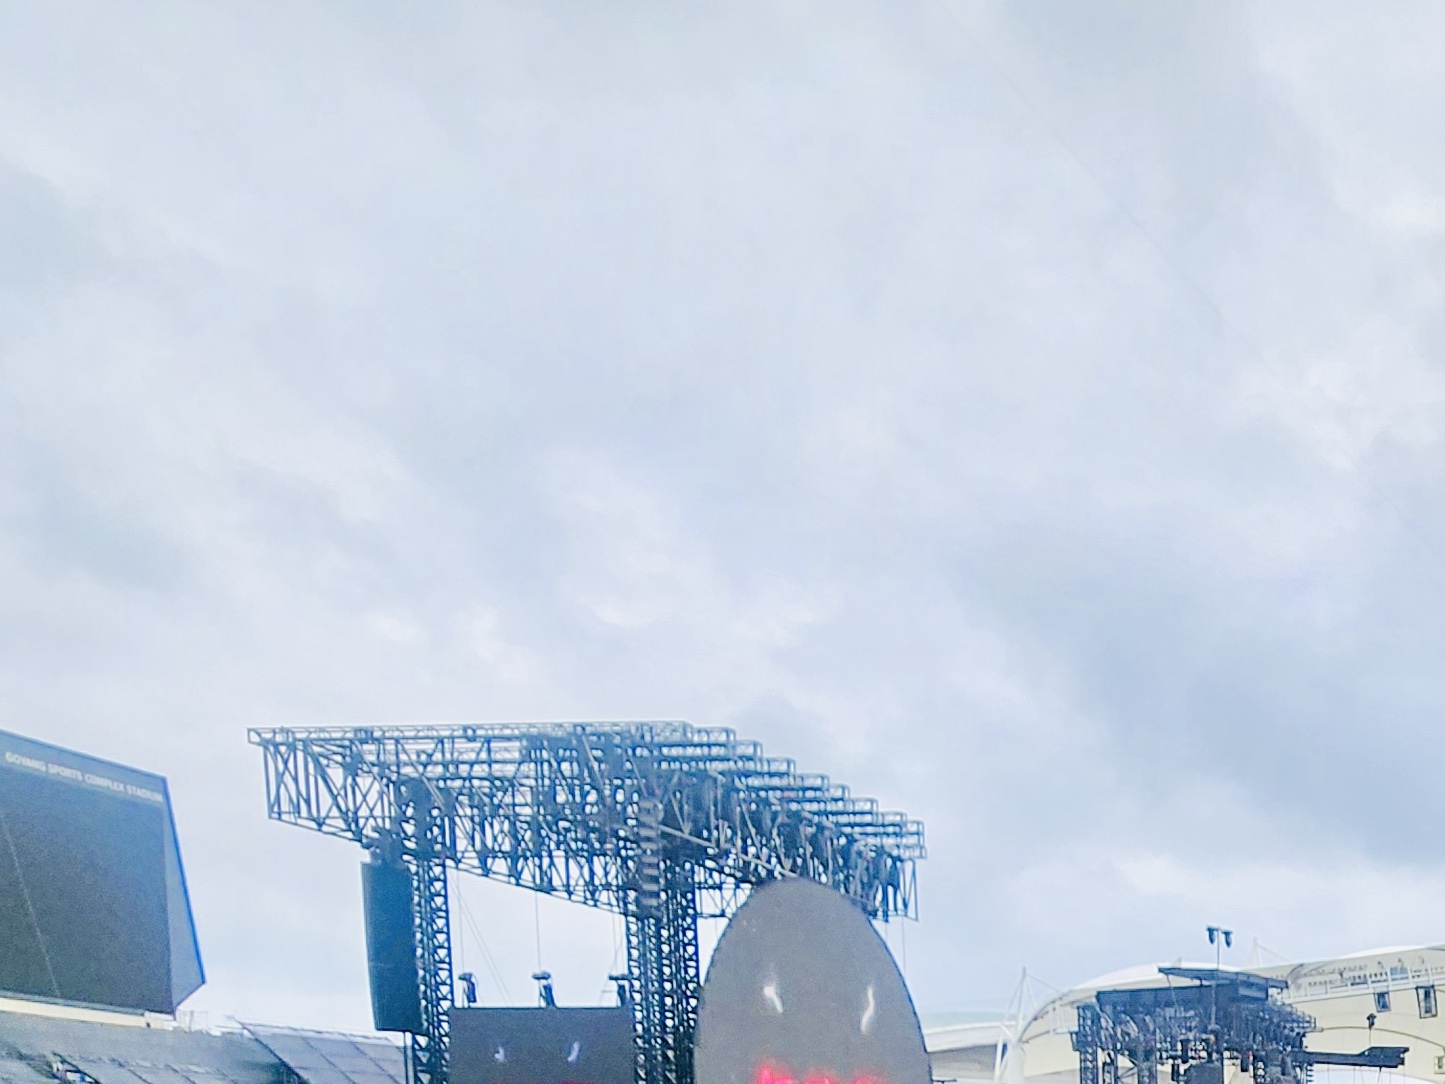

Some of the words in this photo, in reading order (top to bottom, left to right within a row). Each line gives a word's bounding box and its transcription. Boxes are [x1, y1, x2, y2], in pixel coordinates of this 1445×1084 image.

[48, 763, 83, 781] SPORTS
[85, 773, 125, 793] COMPLEX
[126, 784, 163, 802] STADIUM
